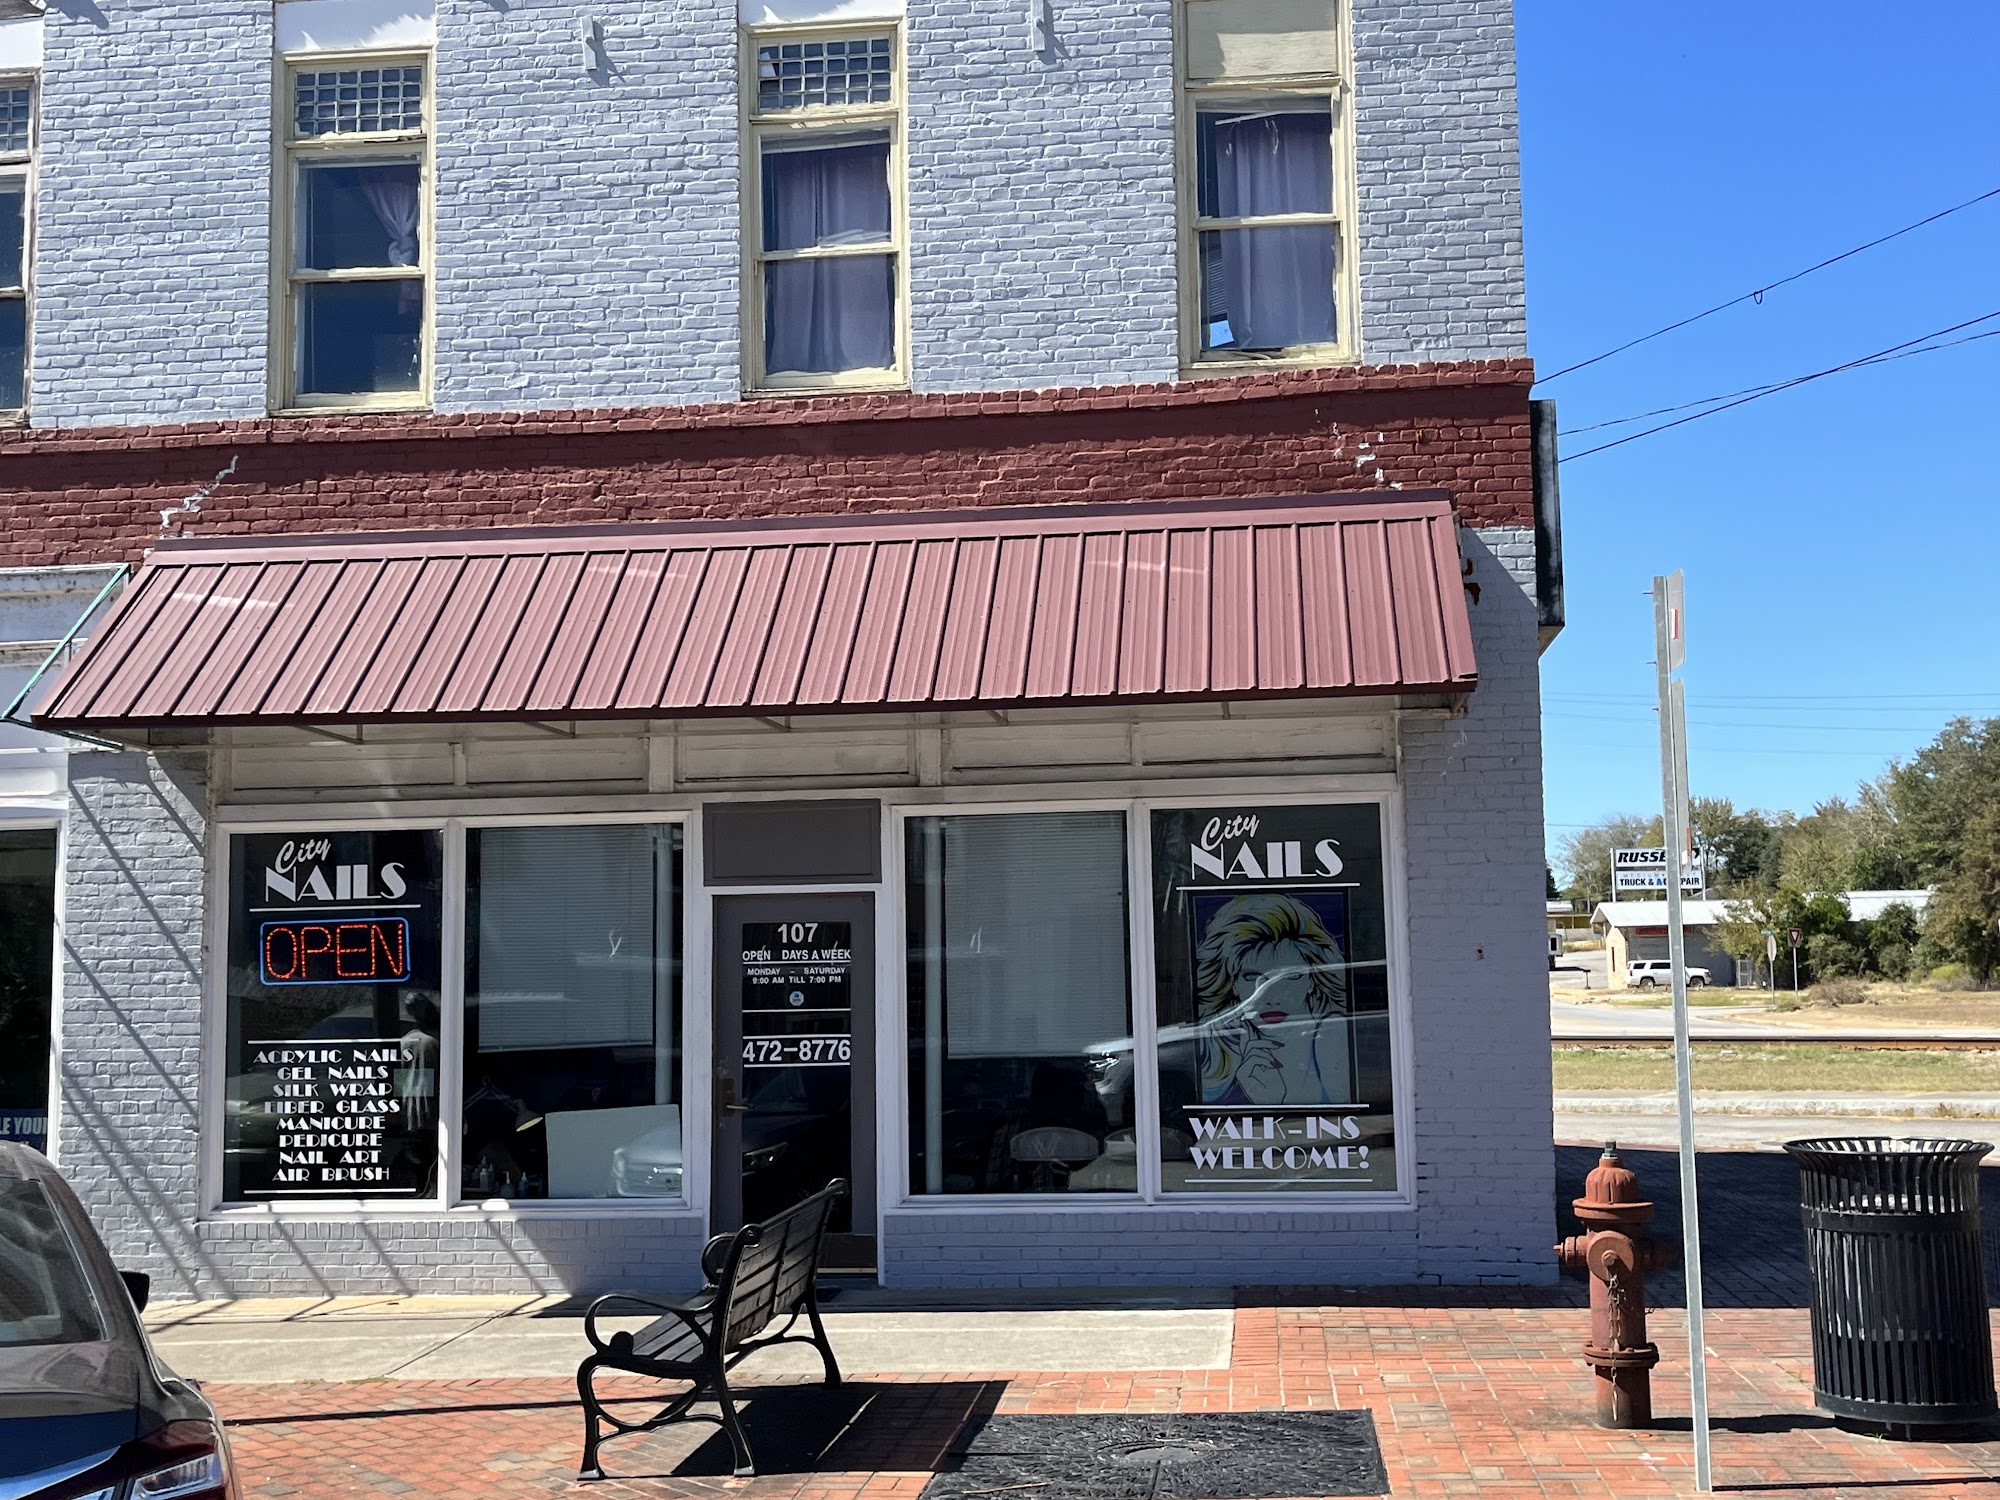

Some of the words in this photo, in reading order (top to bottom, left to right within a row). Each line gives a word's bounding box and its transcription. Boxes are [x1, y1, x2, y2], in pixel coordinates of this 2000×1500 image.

[1201, 814, 1260, 851] City
[275, 839, 331, 873] City
[1190, 839, 1344, 880] NAILS
[265, 862, 407, 902] NAILS
[1620, 878, 1646, 886] TRUCK
[1648, 878, 1654, 886] &
[1680, 877, 1700, 886] PAIR
[778, 922, 818, 943] 107
[266, 924, 404, 979] OPEN
[742, 950, 771, 961] OPEN
[782, 949, 809, 960] DAYS
[811, 949, 819, 960] A
[821, 948, 852, 960] WEEK
[747, 967, 780, 976] MONDAY
[803, 966, 846, 975] SATURDAY
[772, 976, 785, 984] AM
[789, 976, 806, 984] TILL
[829, 975, 842, 983] PM
[253, 1049, 342, 1064] ACRYLIC
[353, 1048, 414, 1063] NAILS
[742, 1039, 851, 1062] 472-8776
[277, 1066, 317, 1081] GEL
[328, 1065, 389, 1080] NAILS
[273, 1083, 319, 1098] SILK
[330, 1082, 393, 1097] WRAP
[264, 1101, 325, 1114] FIBER
[335, 1099, 400, 1114] GLASS
[276, 1115, 386, 1131] MANICURE
[1188, 1115, 1361, 1141] WALK-INS
[279, 1133, 383, 1148] PEDICURE
[279, 1151, 329, 1165] NAIL
[339, 1149, 381, 1164] ART
[1189, 1145, 1370, 1170] WELCOME!
[272, 1168, 310, 1182] AIR
[321, 1166, 390, 1182] BRUSH
